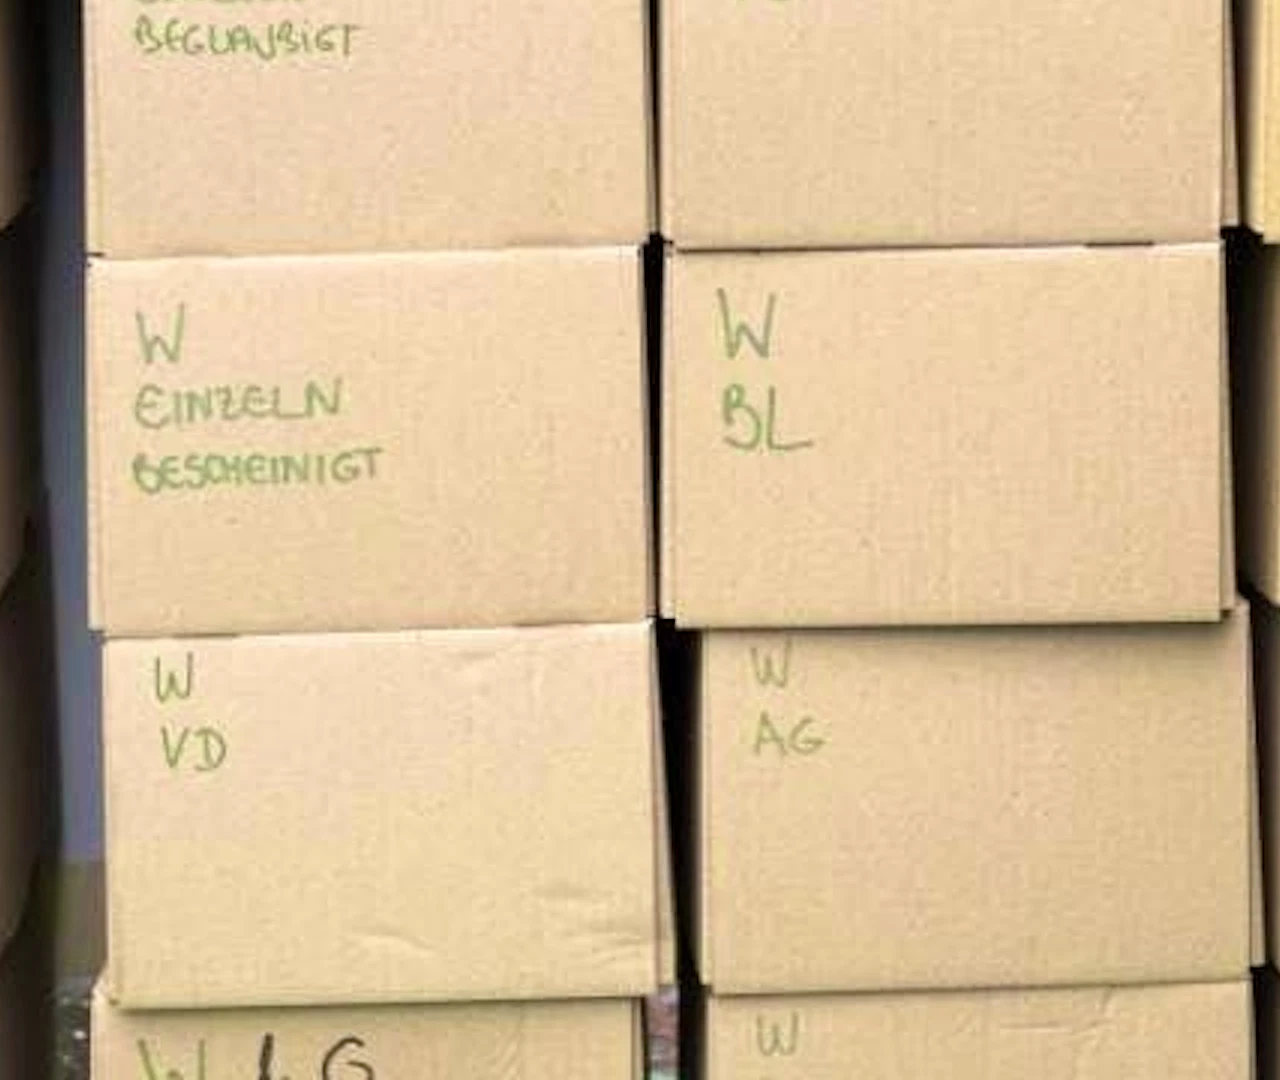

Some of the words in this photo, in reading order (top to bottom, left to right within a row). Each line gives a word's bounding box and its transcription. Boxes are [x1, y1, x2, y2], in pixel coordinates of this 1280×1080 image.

[136, 304, 185, 364] W
[717, 289, 775, 359] W
[722, 382, 813, 455] BL
[154, 653, 193, 703] W
[750, 637, 793, 689] W
[161, 727, 227, 772] VD
[753, 712, 825, 757] AG
[756, 1010, 799, 1057] W
